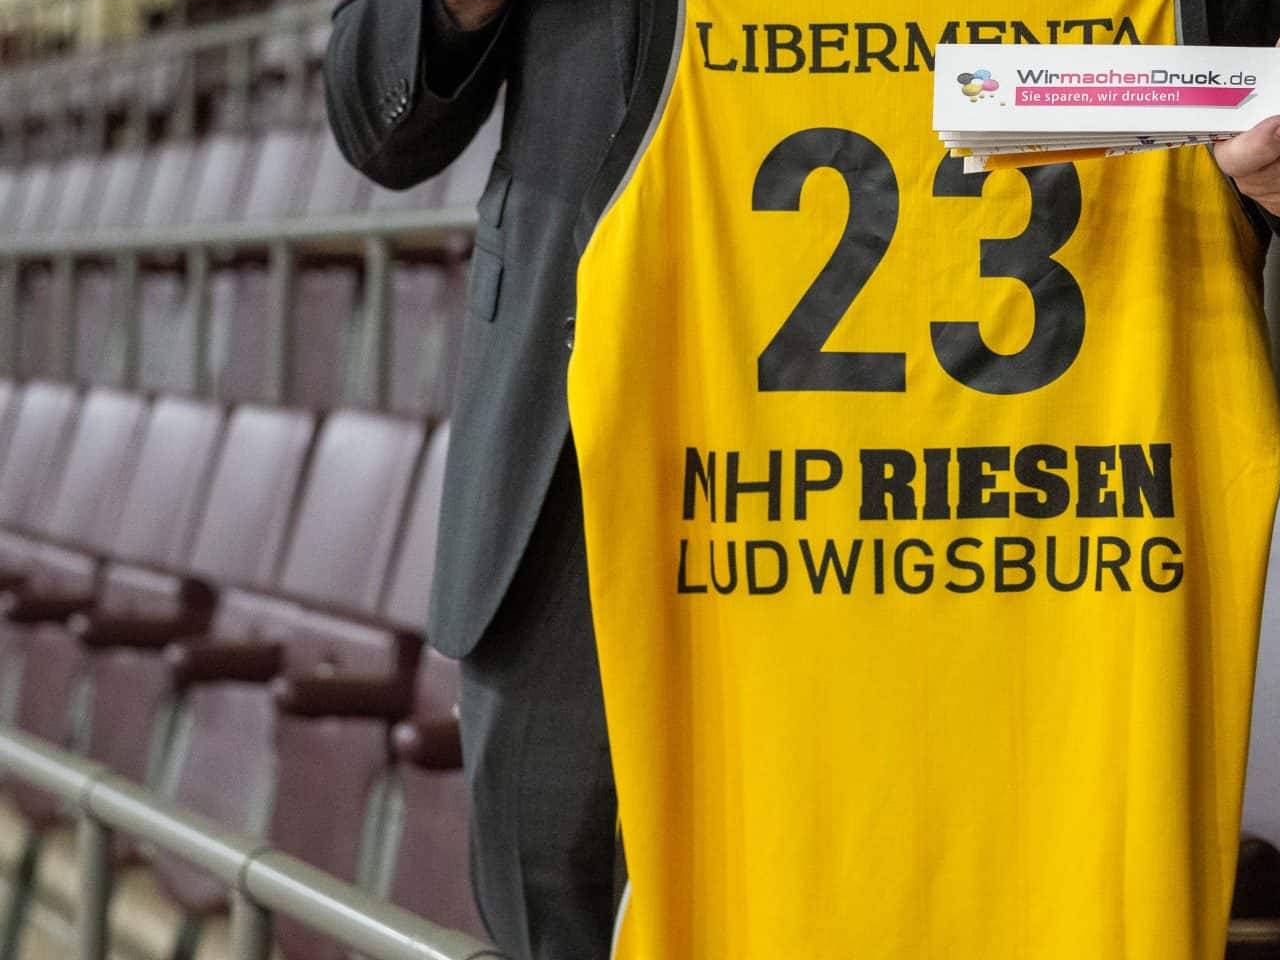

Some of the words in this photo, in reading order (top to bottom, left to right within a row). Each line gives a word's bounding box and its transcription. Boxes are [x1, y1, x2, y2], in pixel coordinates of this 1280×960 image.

[1016, 69, 1256, 85] WirmachenDruck.de
[1021, 90, 1041, 102] Sie
[1044, 92, 1093, 105] sparen,
[1097, 91, 1118, 102] wir
[1121, 90, 1180, 102] drucken!
[752, 127, 1086, 395] 23
[682, 446, 843, 522] NHP
[859, 443, 1175, 521] RIESEN
[677, 536, 1184, 595] LUDWIGSBURG
